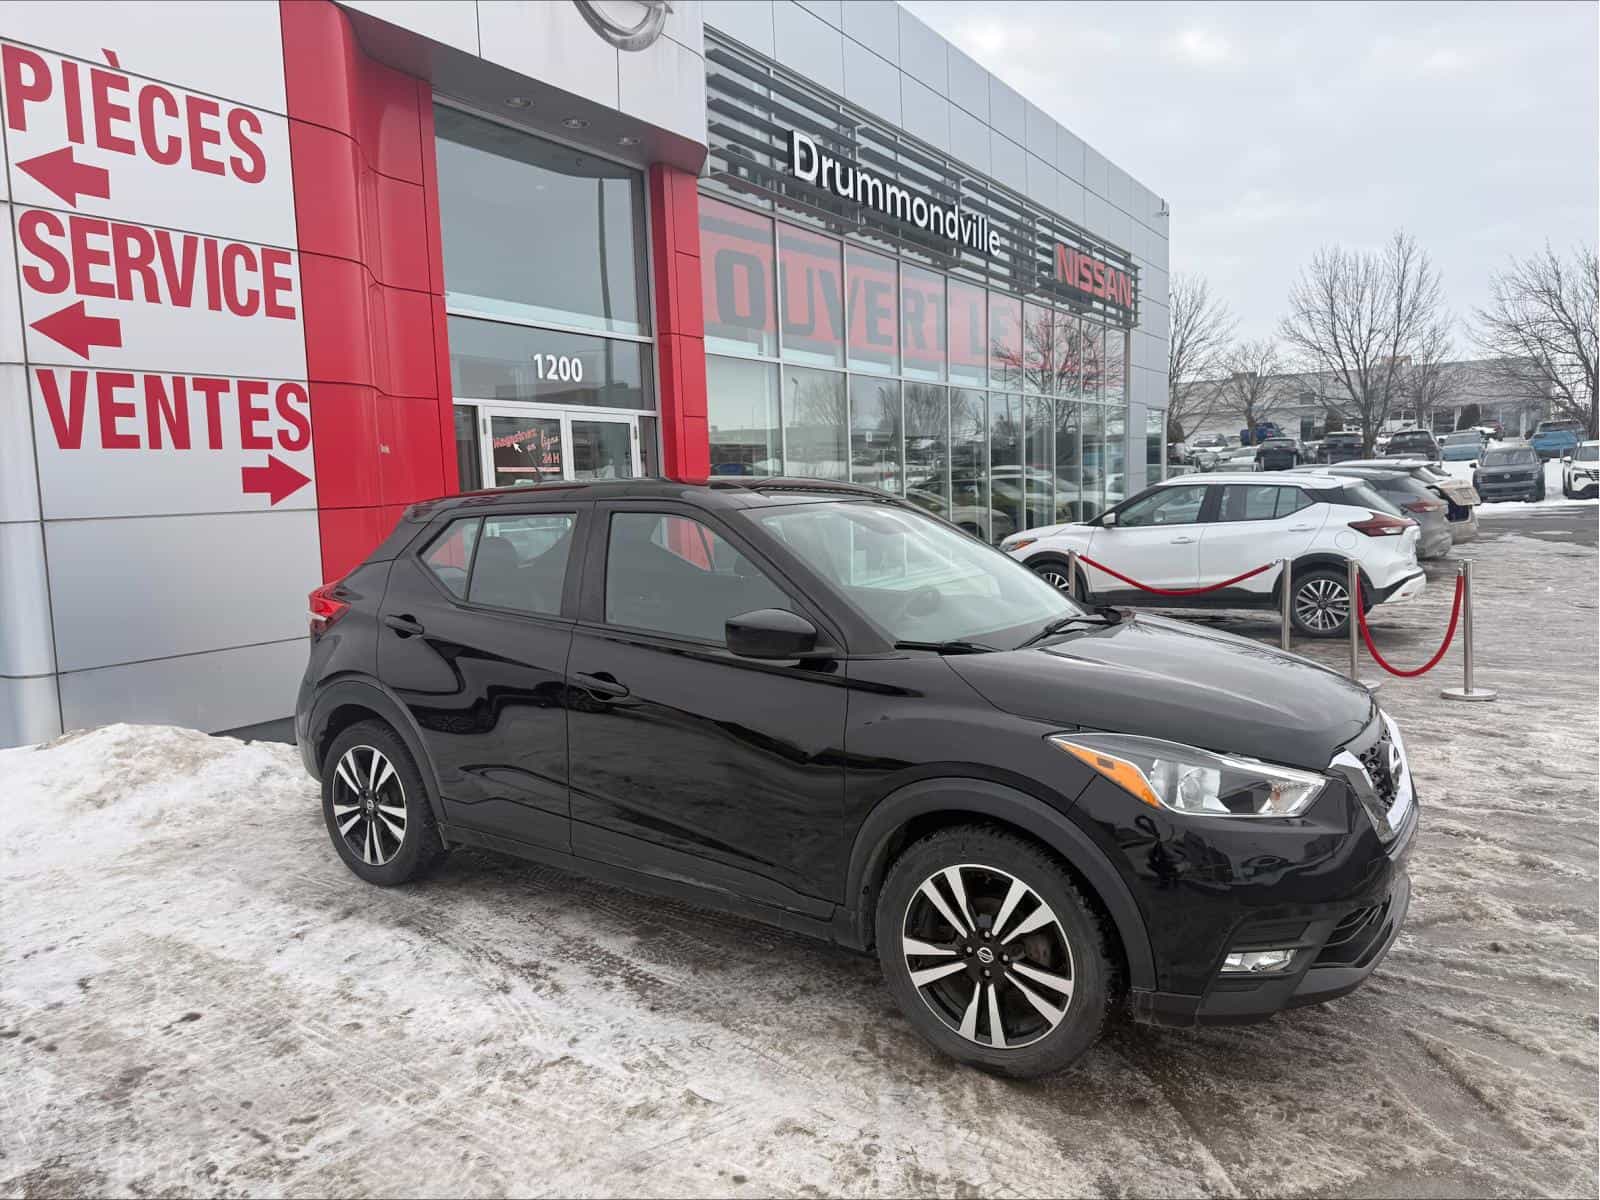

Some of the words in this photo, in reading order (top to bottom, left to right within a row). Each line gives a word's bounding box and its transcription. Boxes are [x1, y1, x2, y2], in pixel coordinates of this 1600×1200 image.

[2, 44, 266, 184] PIÈCES
[792, 130, 1001, 256] Drummondville
[18, 210, 296, 320] SERVICE
[714, 249, 945, 350] OUVERT
[1056, 243, 1132, 308] NISSAN
[35, 369, 311, 452] VENTES
[533, 353, 583, 382] 1200
